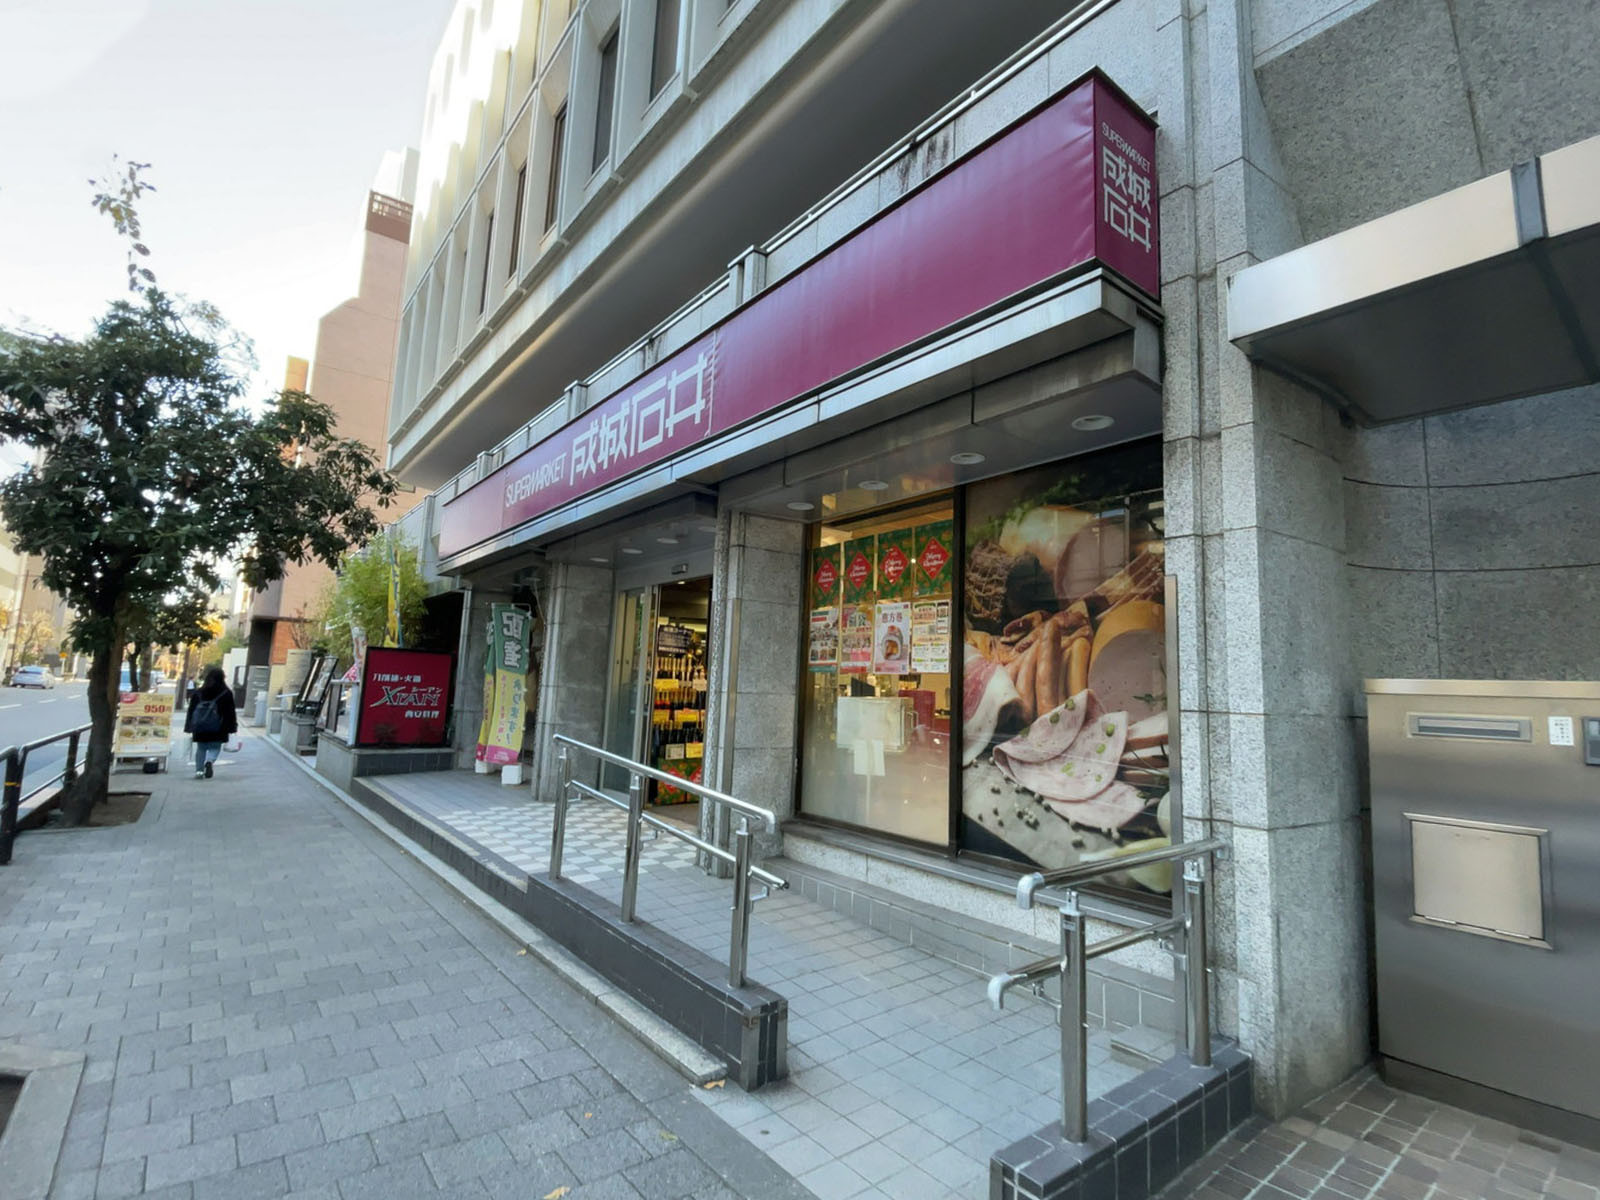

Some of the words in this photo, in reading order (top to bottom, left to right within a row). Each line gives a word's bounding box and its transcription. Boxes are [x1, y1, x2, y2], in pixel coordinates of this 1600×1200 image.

[1102, 122, 1150, 173] SUPERMARKET
[1103, 146, 1151, 214] 成城
[1103, 183, 1151, 253] 石井
[505, 452, 567, 508] SUPERMARKET
[569, 352, 707, 486] 成城石井
